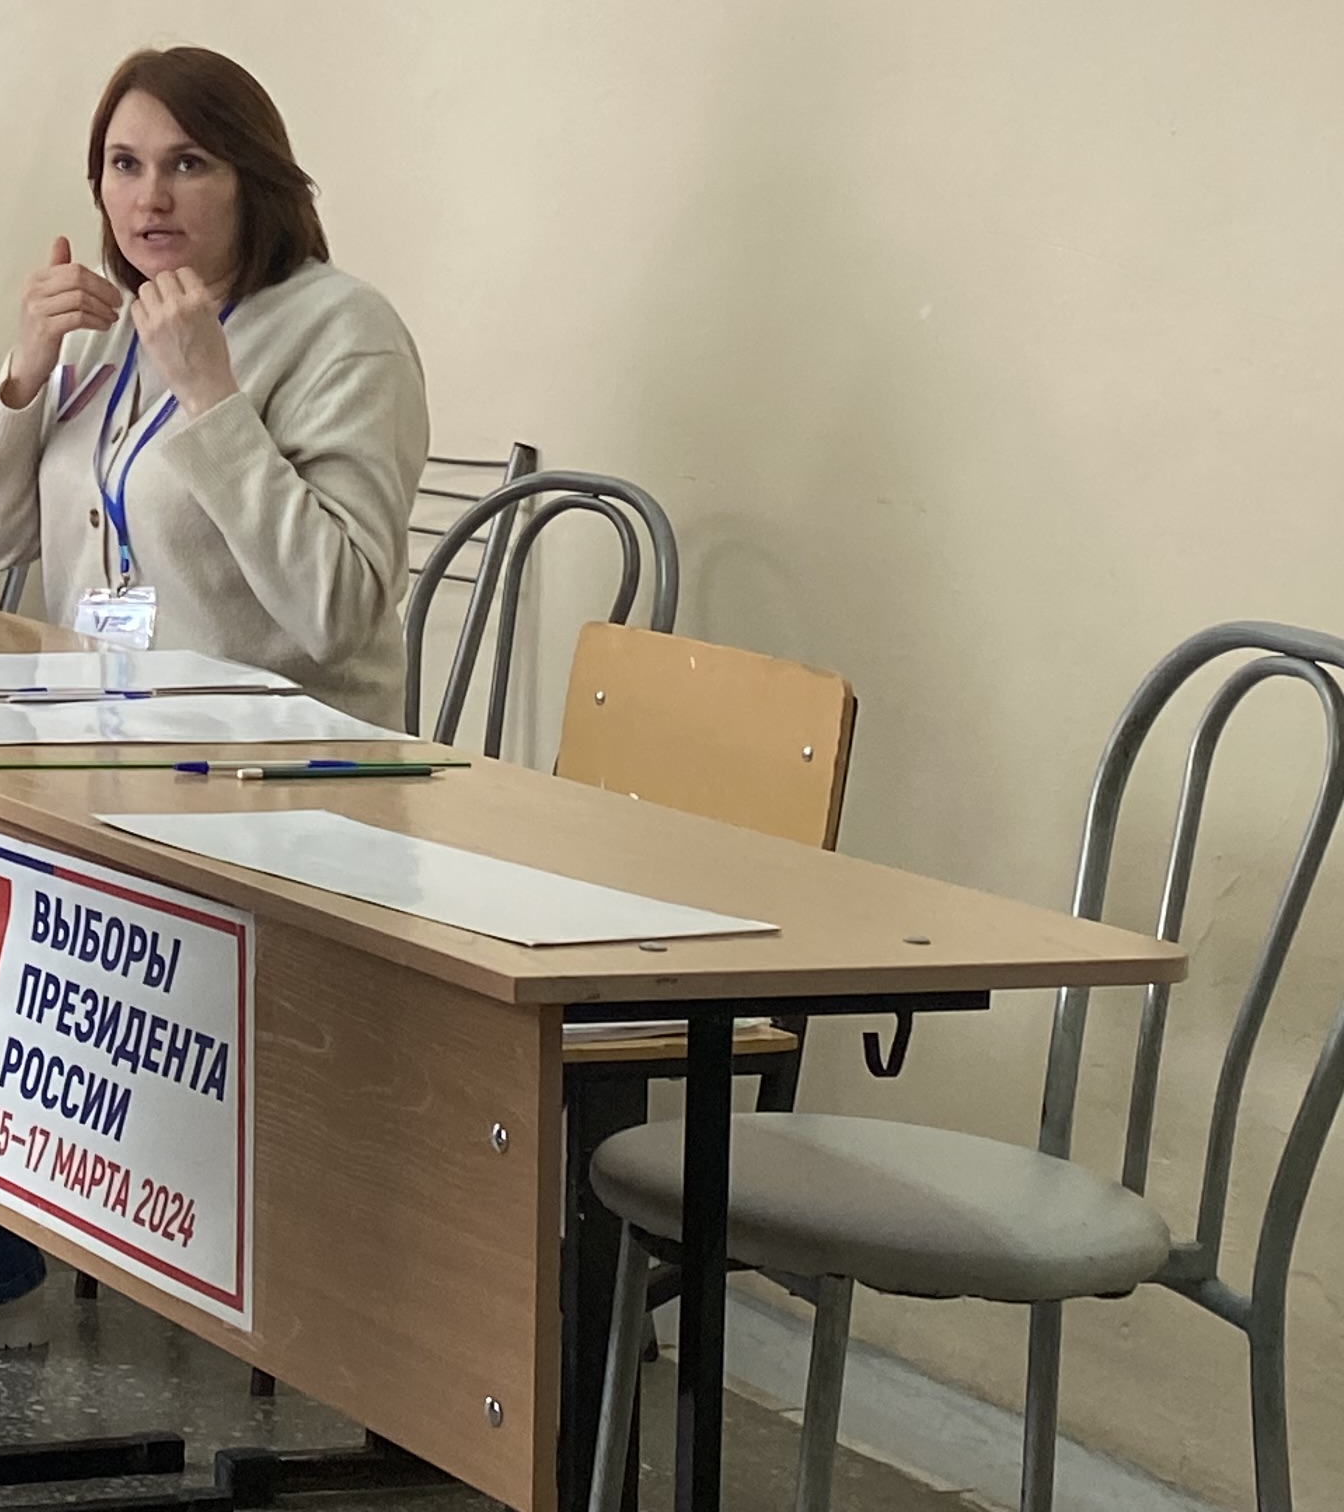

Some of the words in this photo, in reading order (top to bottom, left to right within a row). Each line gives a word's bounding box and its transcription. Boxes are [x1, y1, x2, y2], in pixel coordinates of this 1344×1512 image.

[31, 890, 182, 993] ВЫБОРЫ
[15, 963, 229, 1102] ПРЕЗИДЕНТА
[0, 1037, 132, 1142] РОССИИ
[50, 1150, 132, 1221] МАРТА
[133, 1178, 196, 1248] 2024
